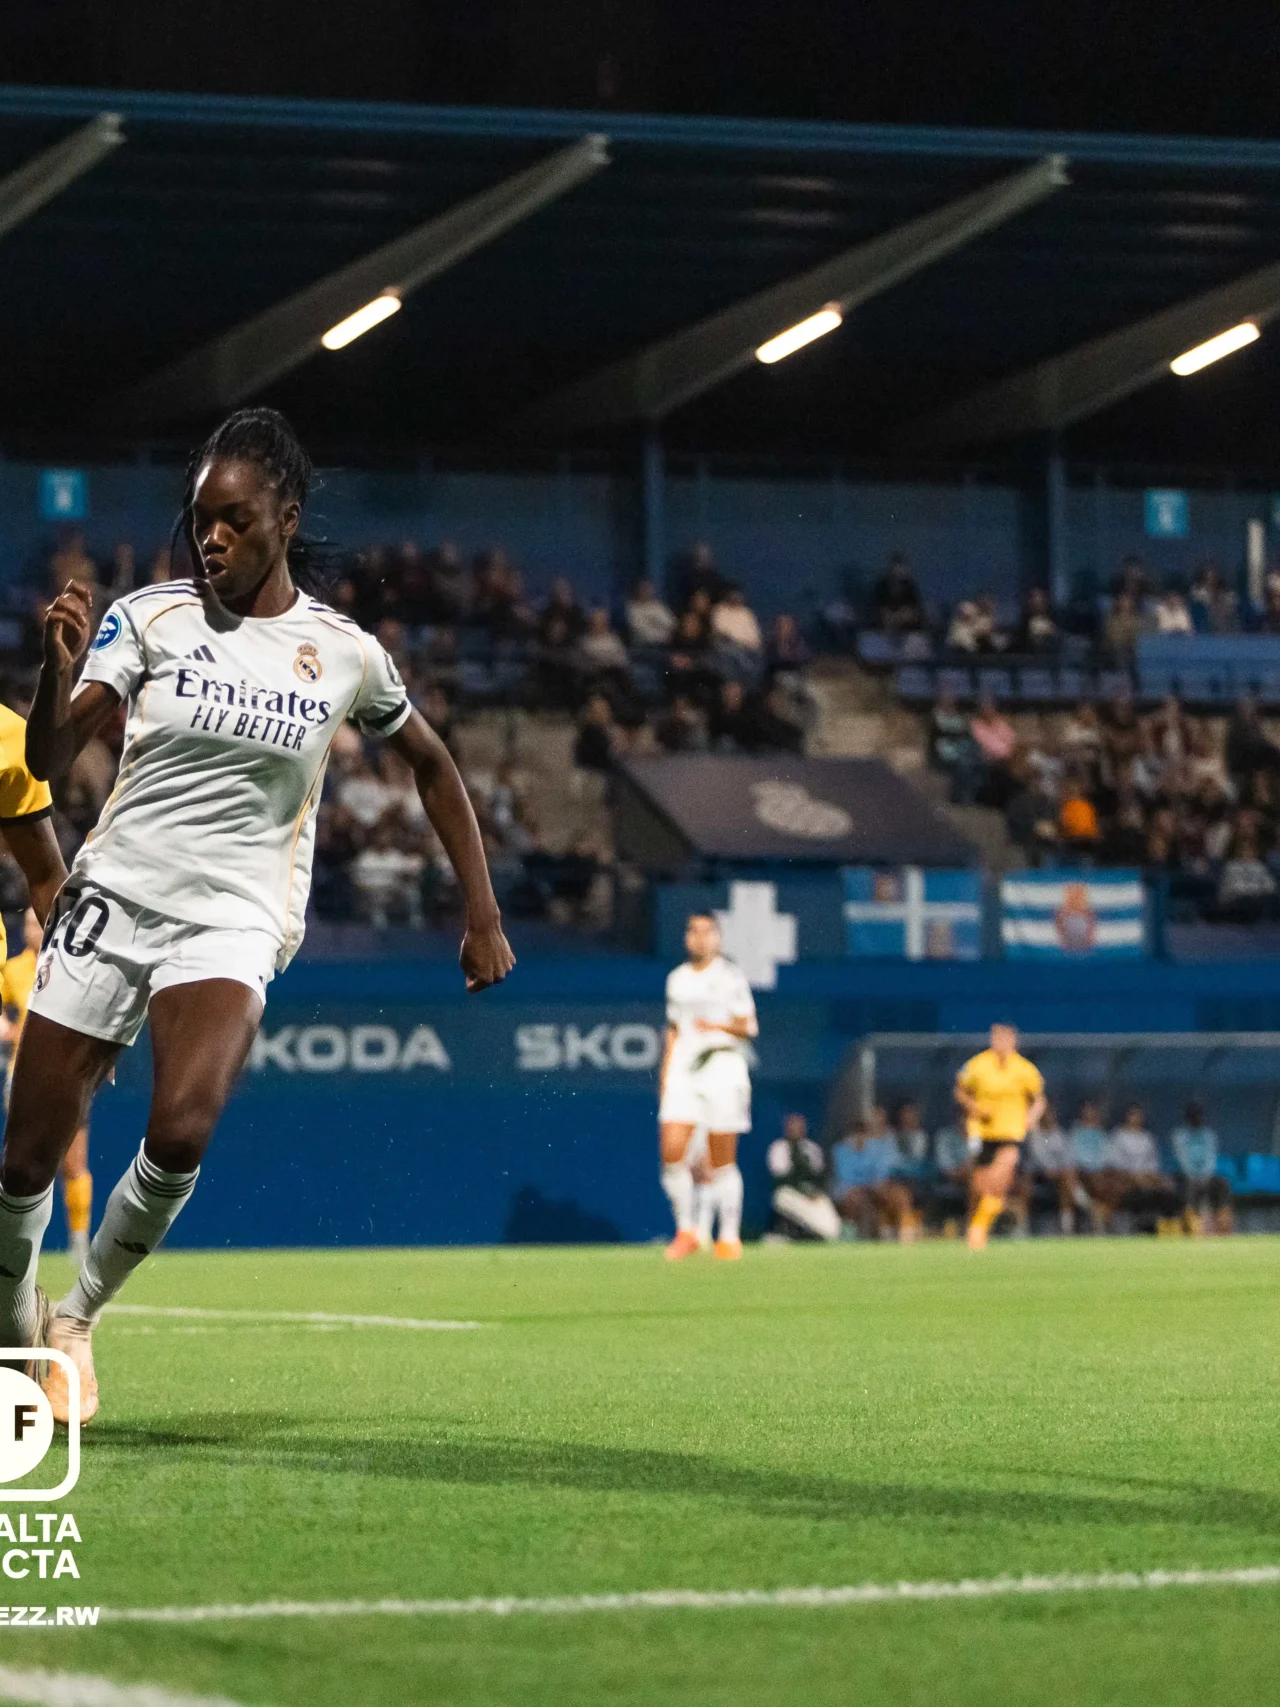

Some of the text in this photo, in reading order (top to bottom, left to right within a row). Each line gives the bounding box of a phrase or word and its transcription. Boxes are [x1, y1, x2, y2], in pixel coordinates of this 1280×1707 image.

[175, 668, 331, 725] Emirates
[190, 704, 308, 752] FLY BETTER
[247, 1023, 451, 1073] KODA
[513, 1021, 663, 1072] SKO
